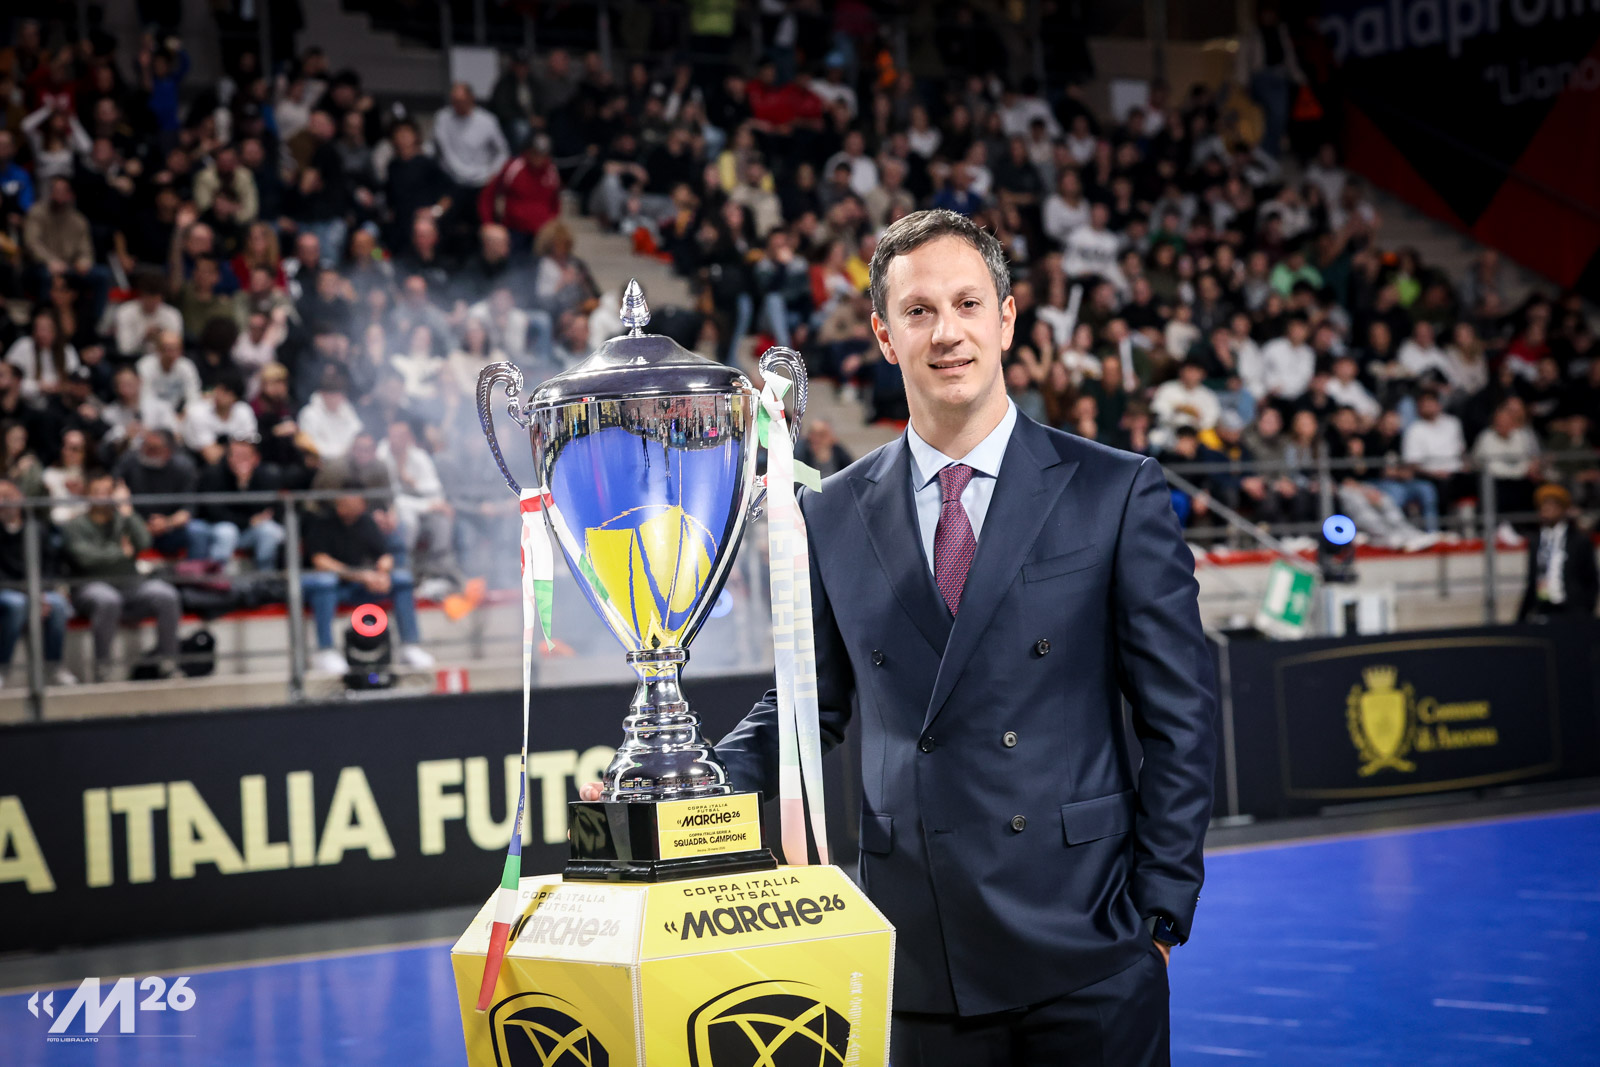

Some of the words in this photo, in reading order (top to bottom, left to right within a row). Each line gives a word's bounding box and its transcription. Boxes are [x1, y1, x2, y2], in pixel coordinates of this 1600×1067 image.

[83, 766, 396, 887] ITALIA
[674, 837, 708, 847] SQUADRA
[710, 833, 746, 844] CAMPIONE
[683, 883, 741, 897] COPPA
[746, 876, 801, 890] ITALIA
[522, 890, 562, 900] COPPA
[565, 893, 606, 903] ITALIA
[715, 889, 781, 903] FUTSAL
[537, 902, 583, 913] FUTSAL
